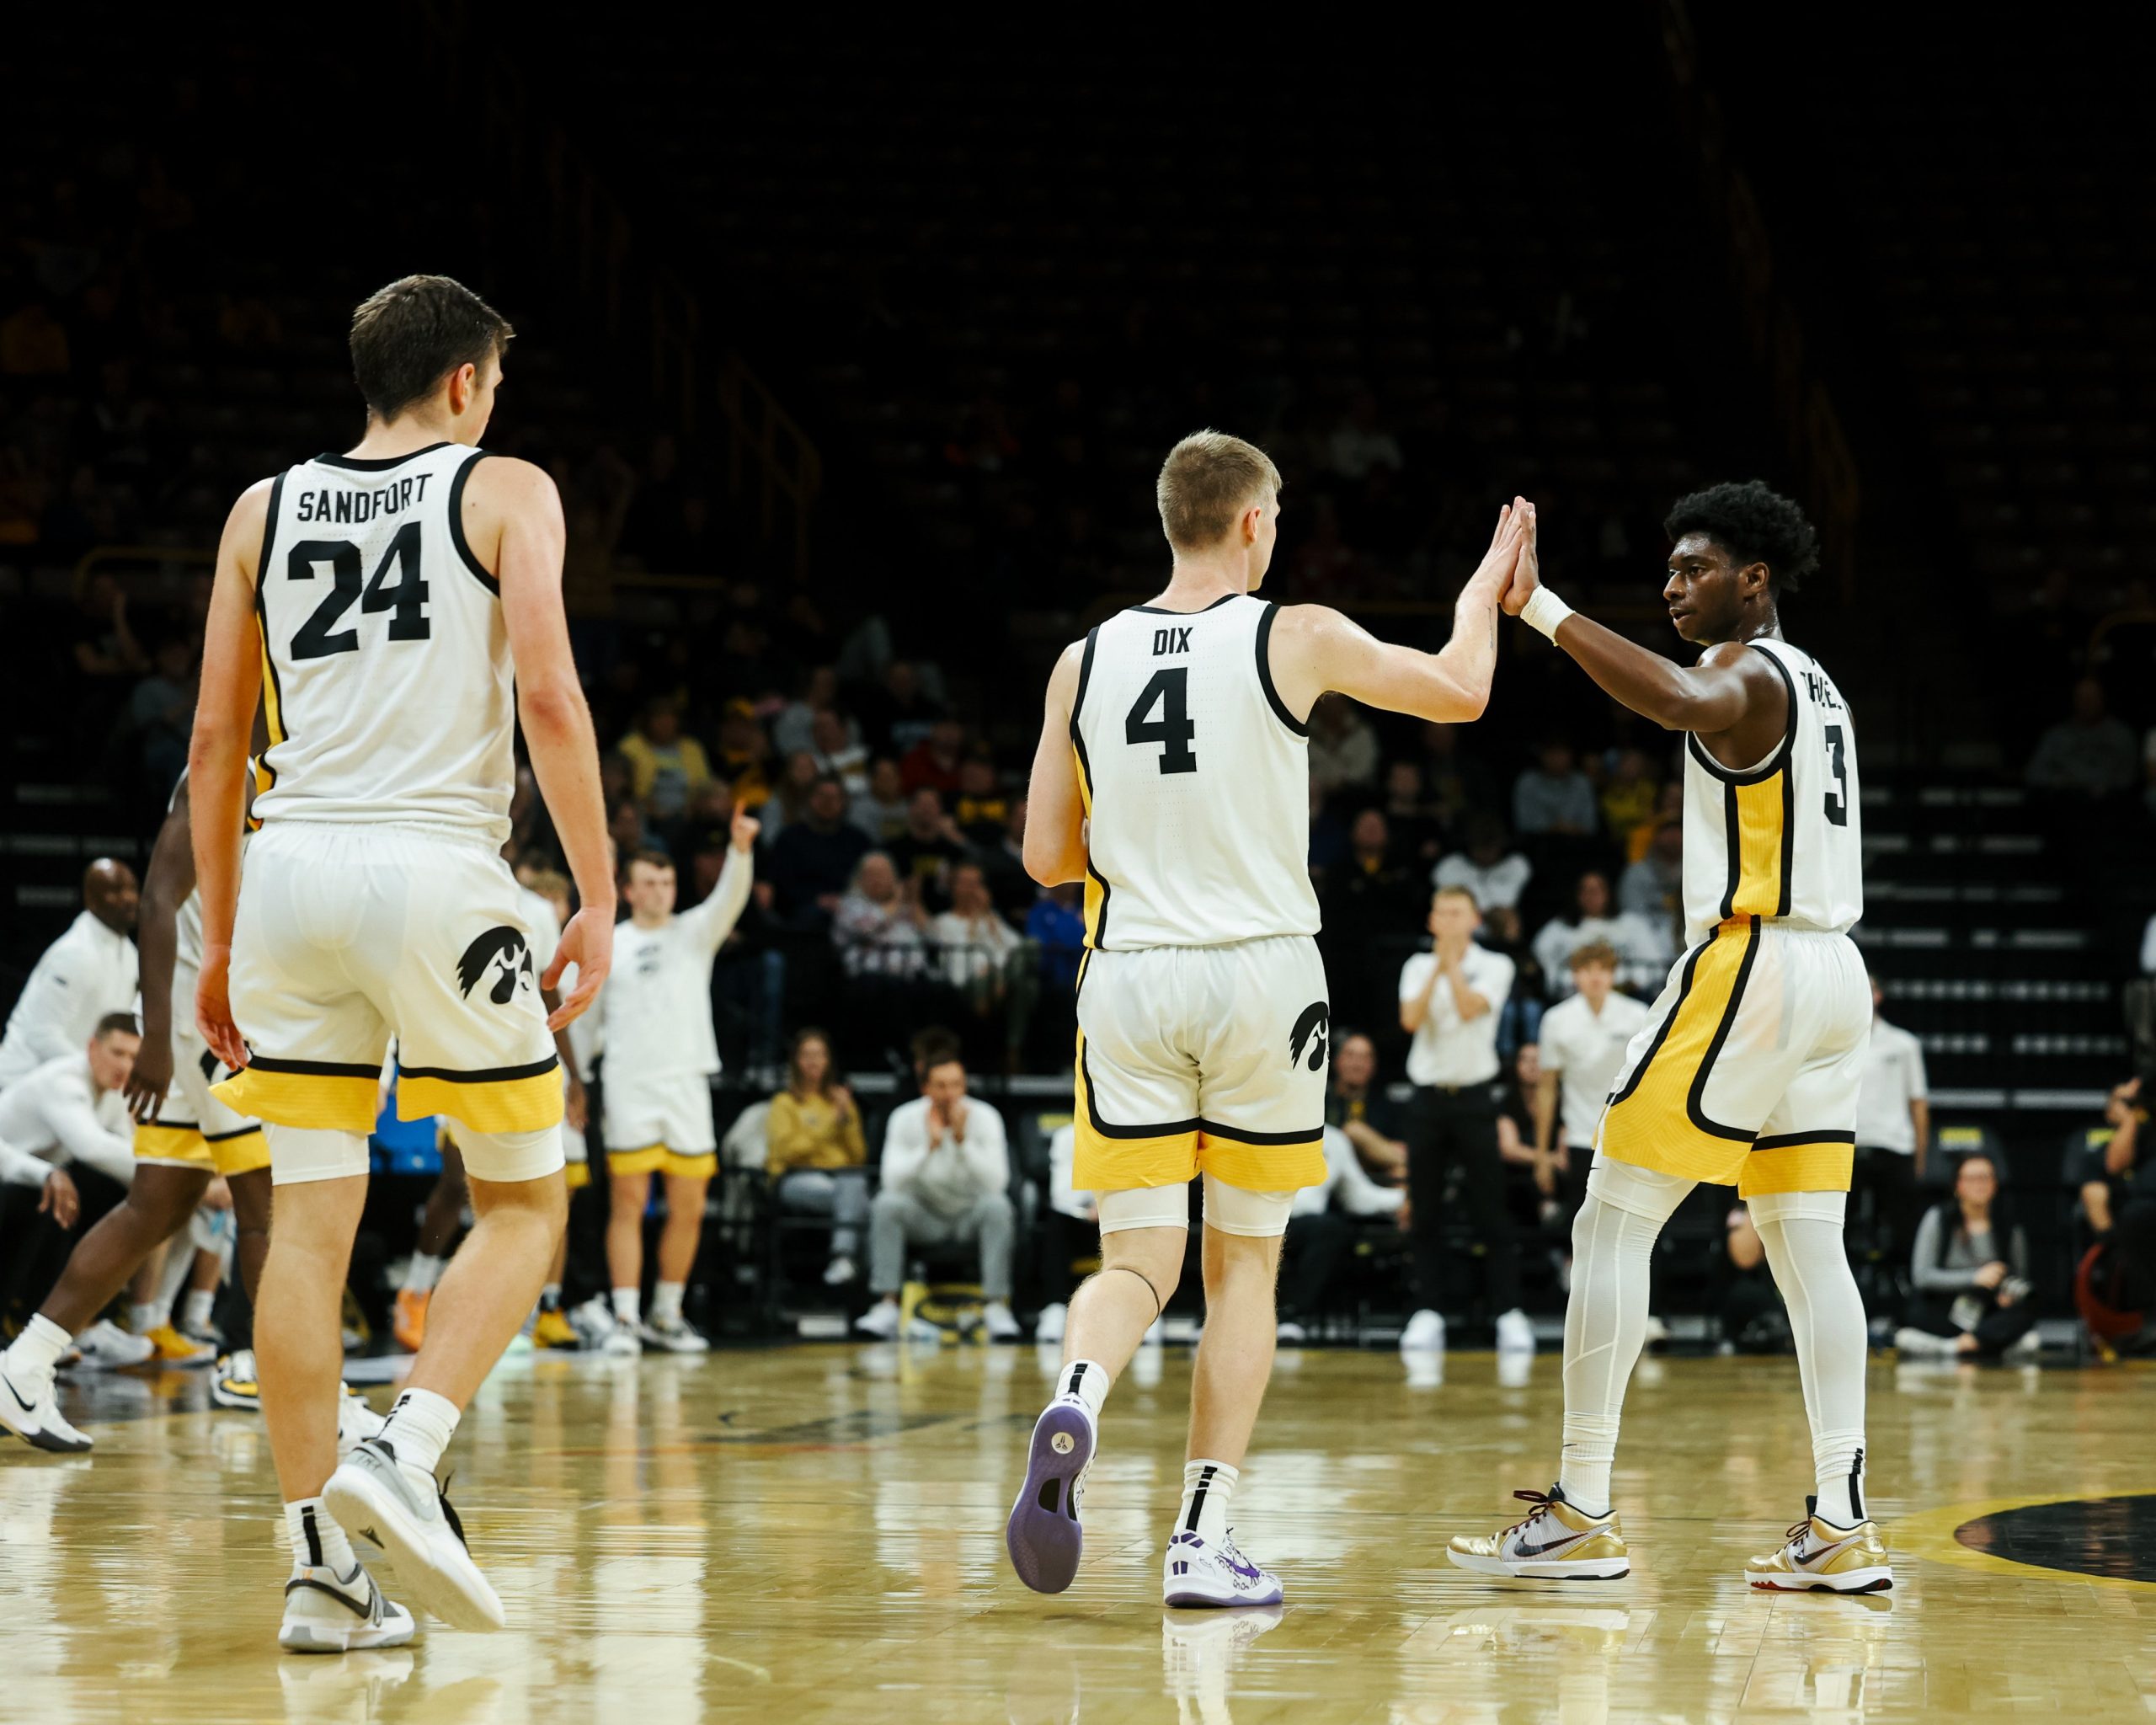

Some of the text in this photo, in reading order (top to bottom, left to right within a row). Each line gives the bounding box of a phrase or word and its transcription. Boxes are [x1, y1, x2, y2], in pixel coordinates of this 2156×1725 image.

[297, 473, 433, 523] SANDFORT
[287, 521, 430, 660] 24
[1153, 627, 1193, 655] DIX
[1125, 667, 1197, 775] 4
[1823, 724, 1847, 827] 3
